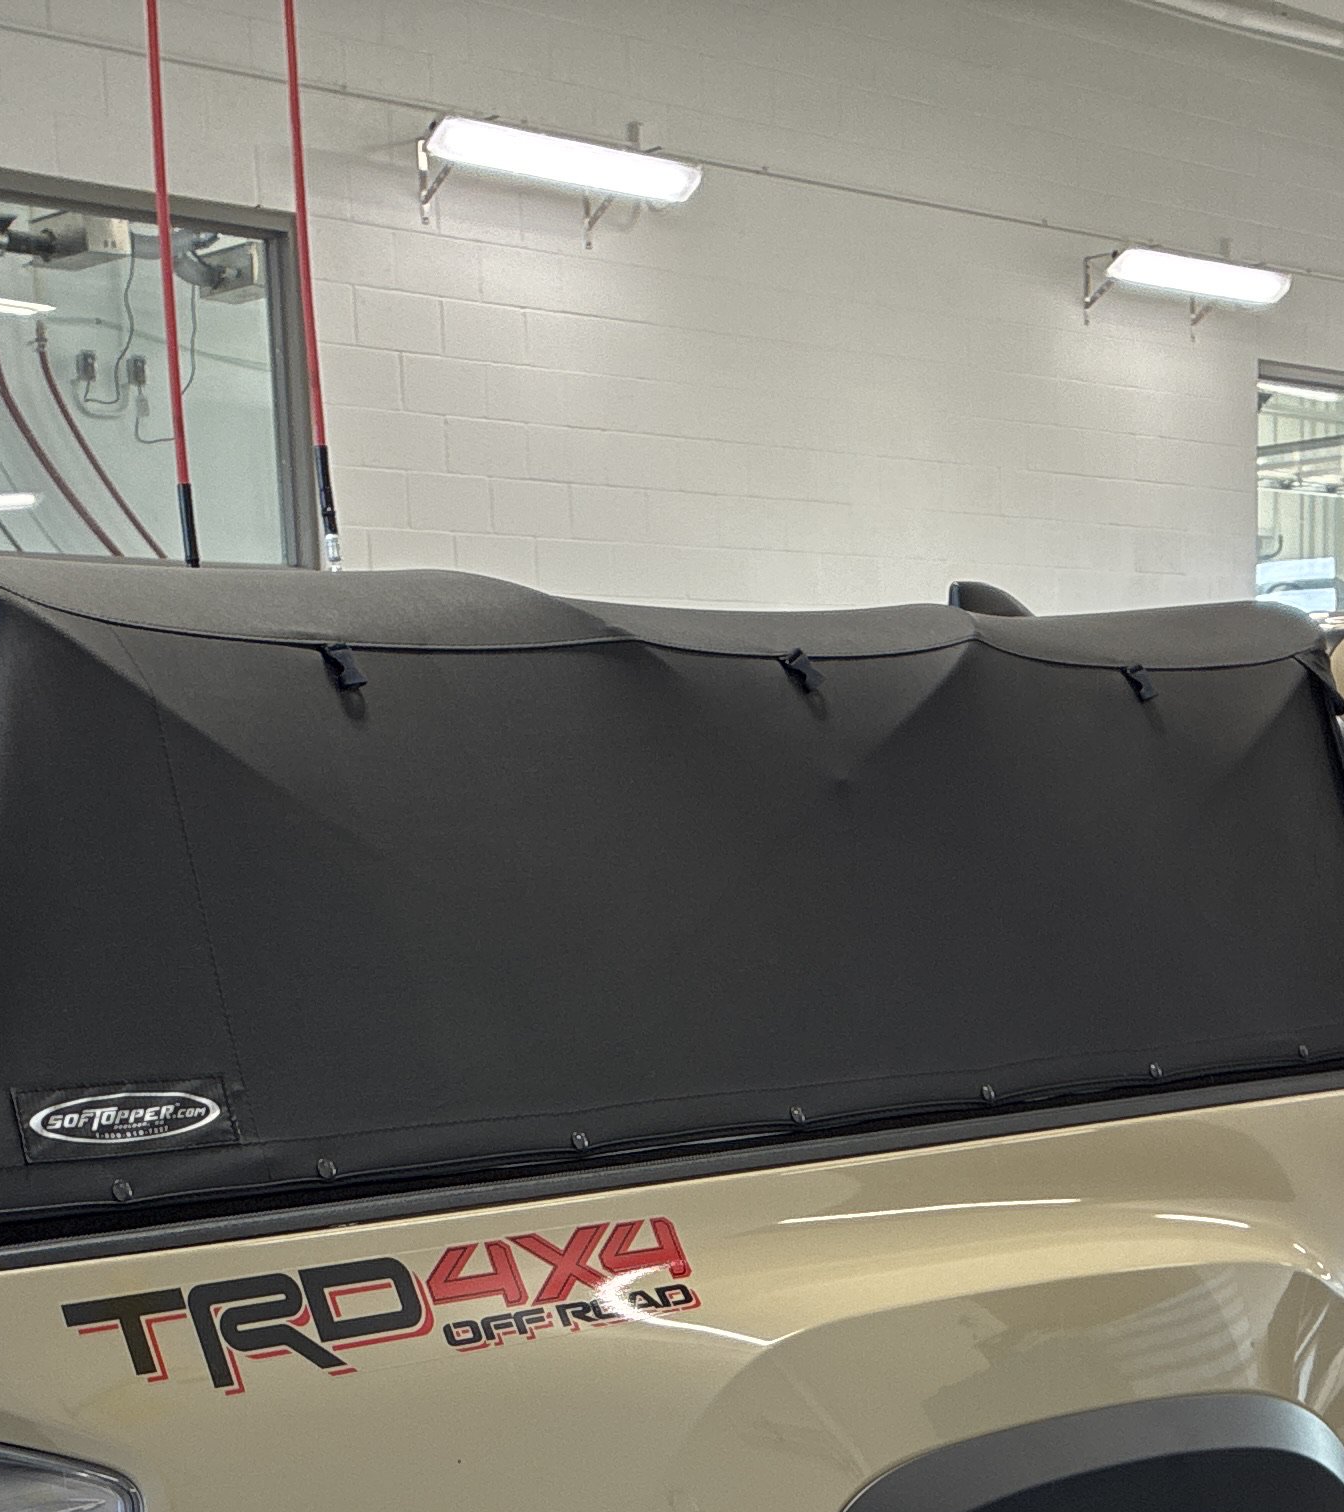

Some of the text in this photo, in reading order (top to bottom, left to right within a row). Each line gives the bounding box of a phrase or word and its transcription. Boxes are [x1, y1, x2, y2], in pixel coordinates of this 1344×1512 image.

[63, 1217, 693, 1395] TRD 4X4
[443, 1307, 554, 1352] OFF
